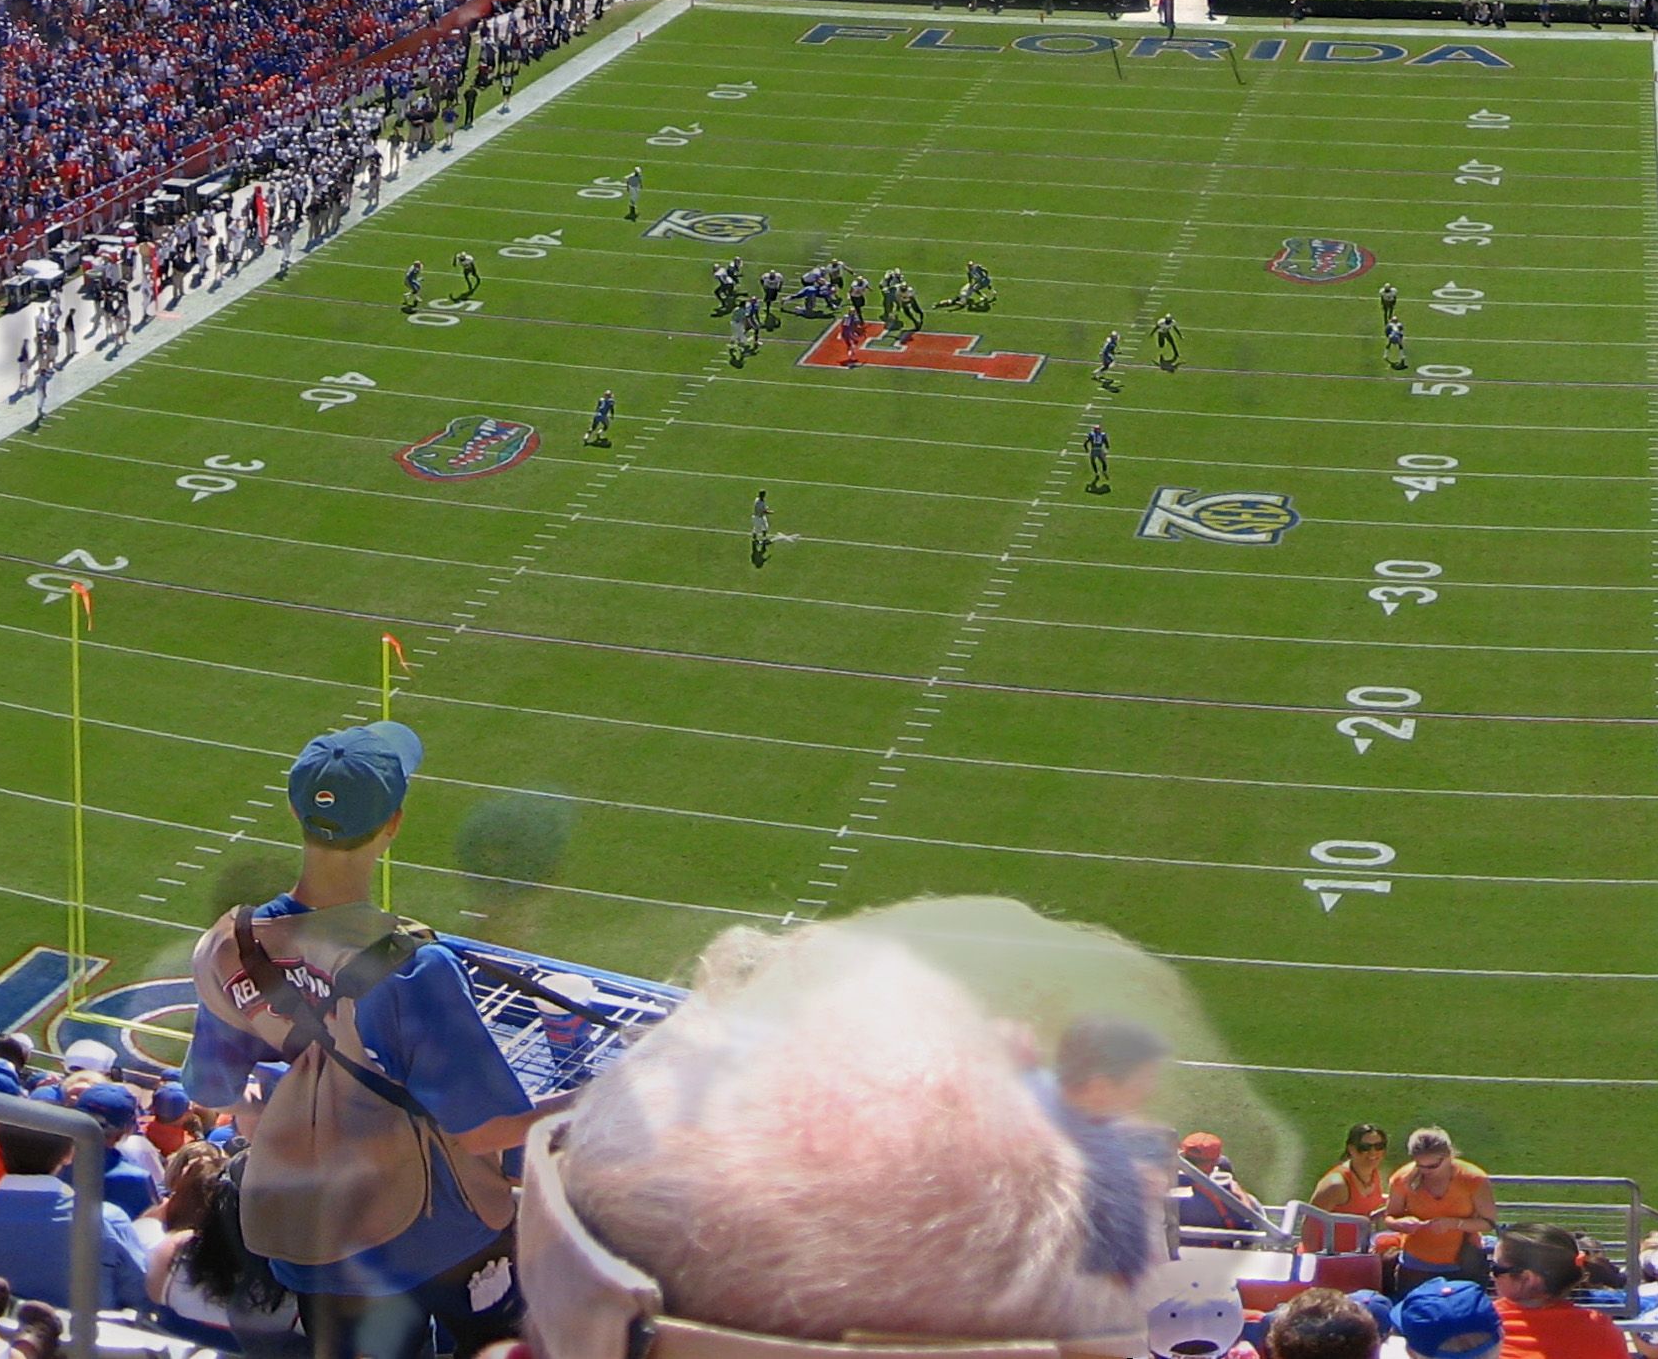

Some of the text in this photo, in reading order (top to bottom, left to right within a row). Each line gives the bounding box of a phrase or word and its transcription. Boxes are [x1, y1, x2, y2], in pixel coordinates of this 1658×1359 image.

[795, 23, 1514, 69] FLORIDA
[707, 81, 756, 101] 10
[646, 123, 703, 147] 20
[1466, 110, 1511, 130] 10
[576, 176, 629, 200] 30
[1455, 160, 1503, 186] 20
[498, 229, 563, 259] 40
[1442, 217, 1494, 246] 30
[407, 297, 483, 327] 50
[1429, 282, 1485, 316] 40
[300, 371, 377, 405] 40
[1411, 364, 1474, 397] 50
[175, 454, 265, 493] 30
[1392, 453, 1459, 495] 40
[25, 549, 130, 596] 20
[1367, 559, 1443, 606] 30
[1336, 686, 1423, 742] 20
[1303, 839, 1397, 894] 10
